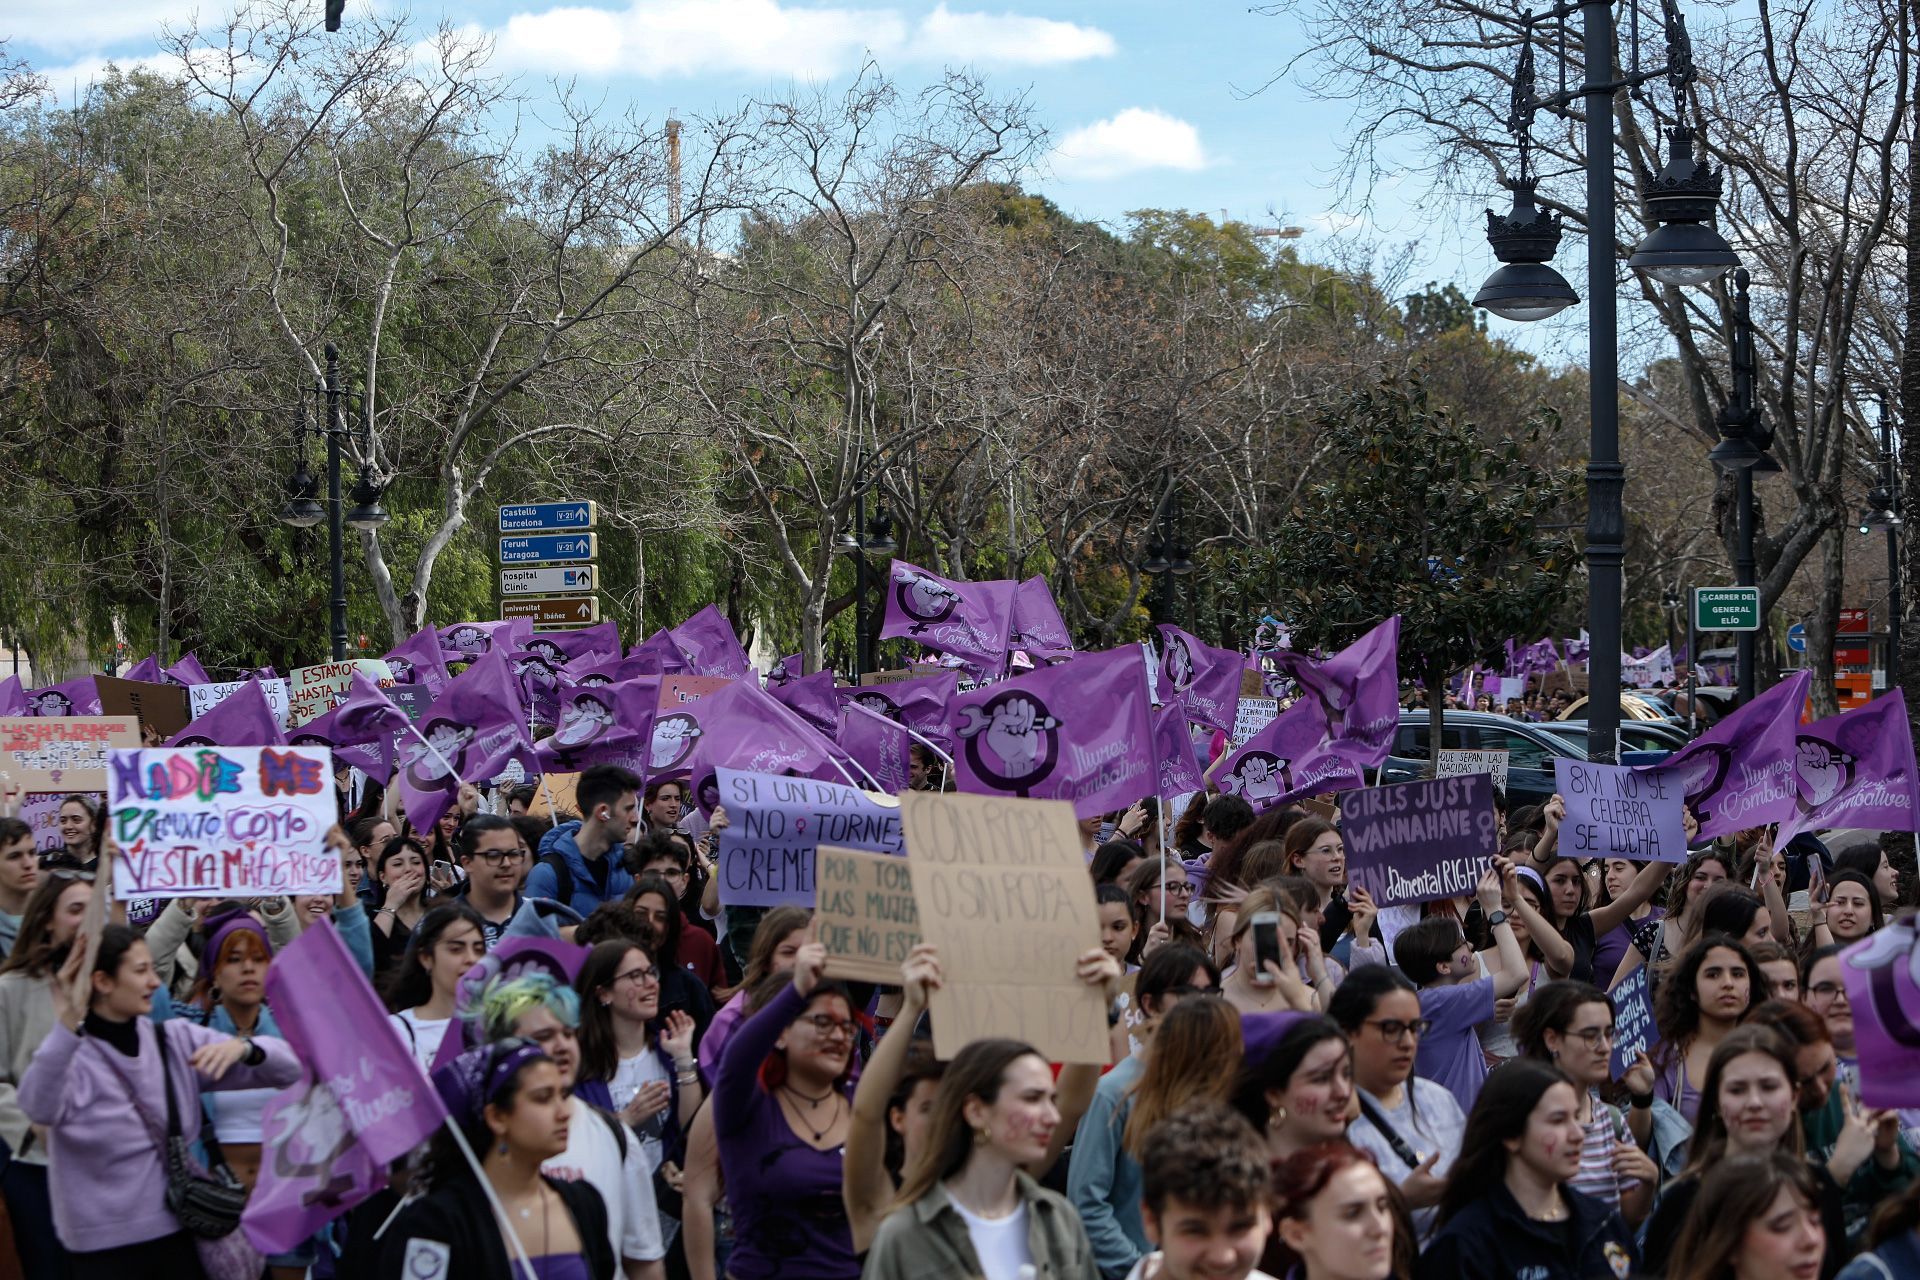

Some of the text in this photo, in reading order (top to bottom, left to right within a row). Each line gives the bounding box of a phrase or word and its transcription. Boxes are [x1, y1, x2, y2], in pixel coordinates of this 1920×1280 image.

[502, 507, 537, 517] Castelló
[502, 519, 543, 528] Barcelona
[503, 540, 528, 548] Teruel
[558, 543, 573, 551] V-21
[503, 551, 539, 560] Zaragoza
[503, 571, 537, 581] hospital
[505, 604, 540, 612] universitat
[544, 611, 565, 619] Ibáñez
[1721, 617, 1740, 625] ELÍO
[303, 662, 361, 684] ESTAMOS
[193, 689, 207, 701] NO
[295, 684, 333, 702] HASTA
[300, 704, 316, 717] DE
[1459, 752, 1482, 762] SEPAN
[1488, 753, 1502, 763] LAS
[1440, 763, 1472, 773] NACIDAS
[1487, 765, 1499, 773] LAS
[1570, 765, 1668, 800] 8M NO SE
[774, 782, 807, 803] UN
[816, 785, 859, 806] DIA
[1343, 777, 1476, 820] GIRLS JUST
[228, 808, 307, 841] COMO
[911, 796, 985, 864] CON
[1575, 824, 1660, 856] SE LUCHA
[824, 856, 859, 883] POR
[931, 872, 952, 918] O
[821, 890, 854, 917] LAS
[820, 922, 850, 954] QUE
[857, 925, 879, 957] NO
